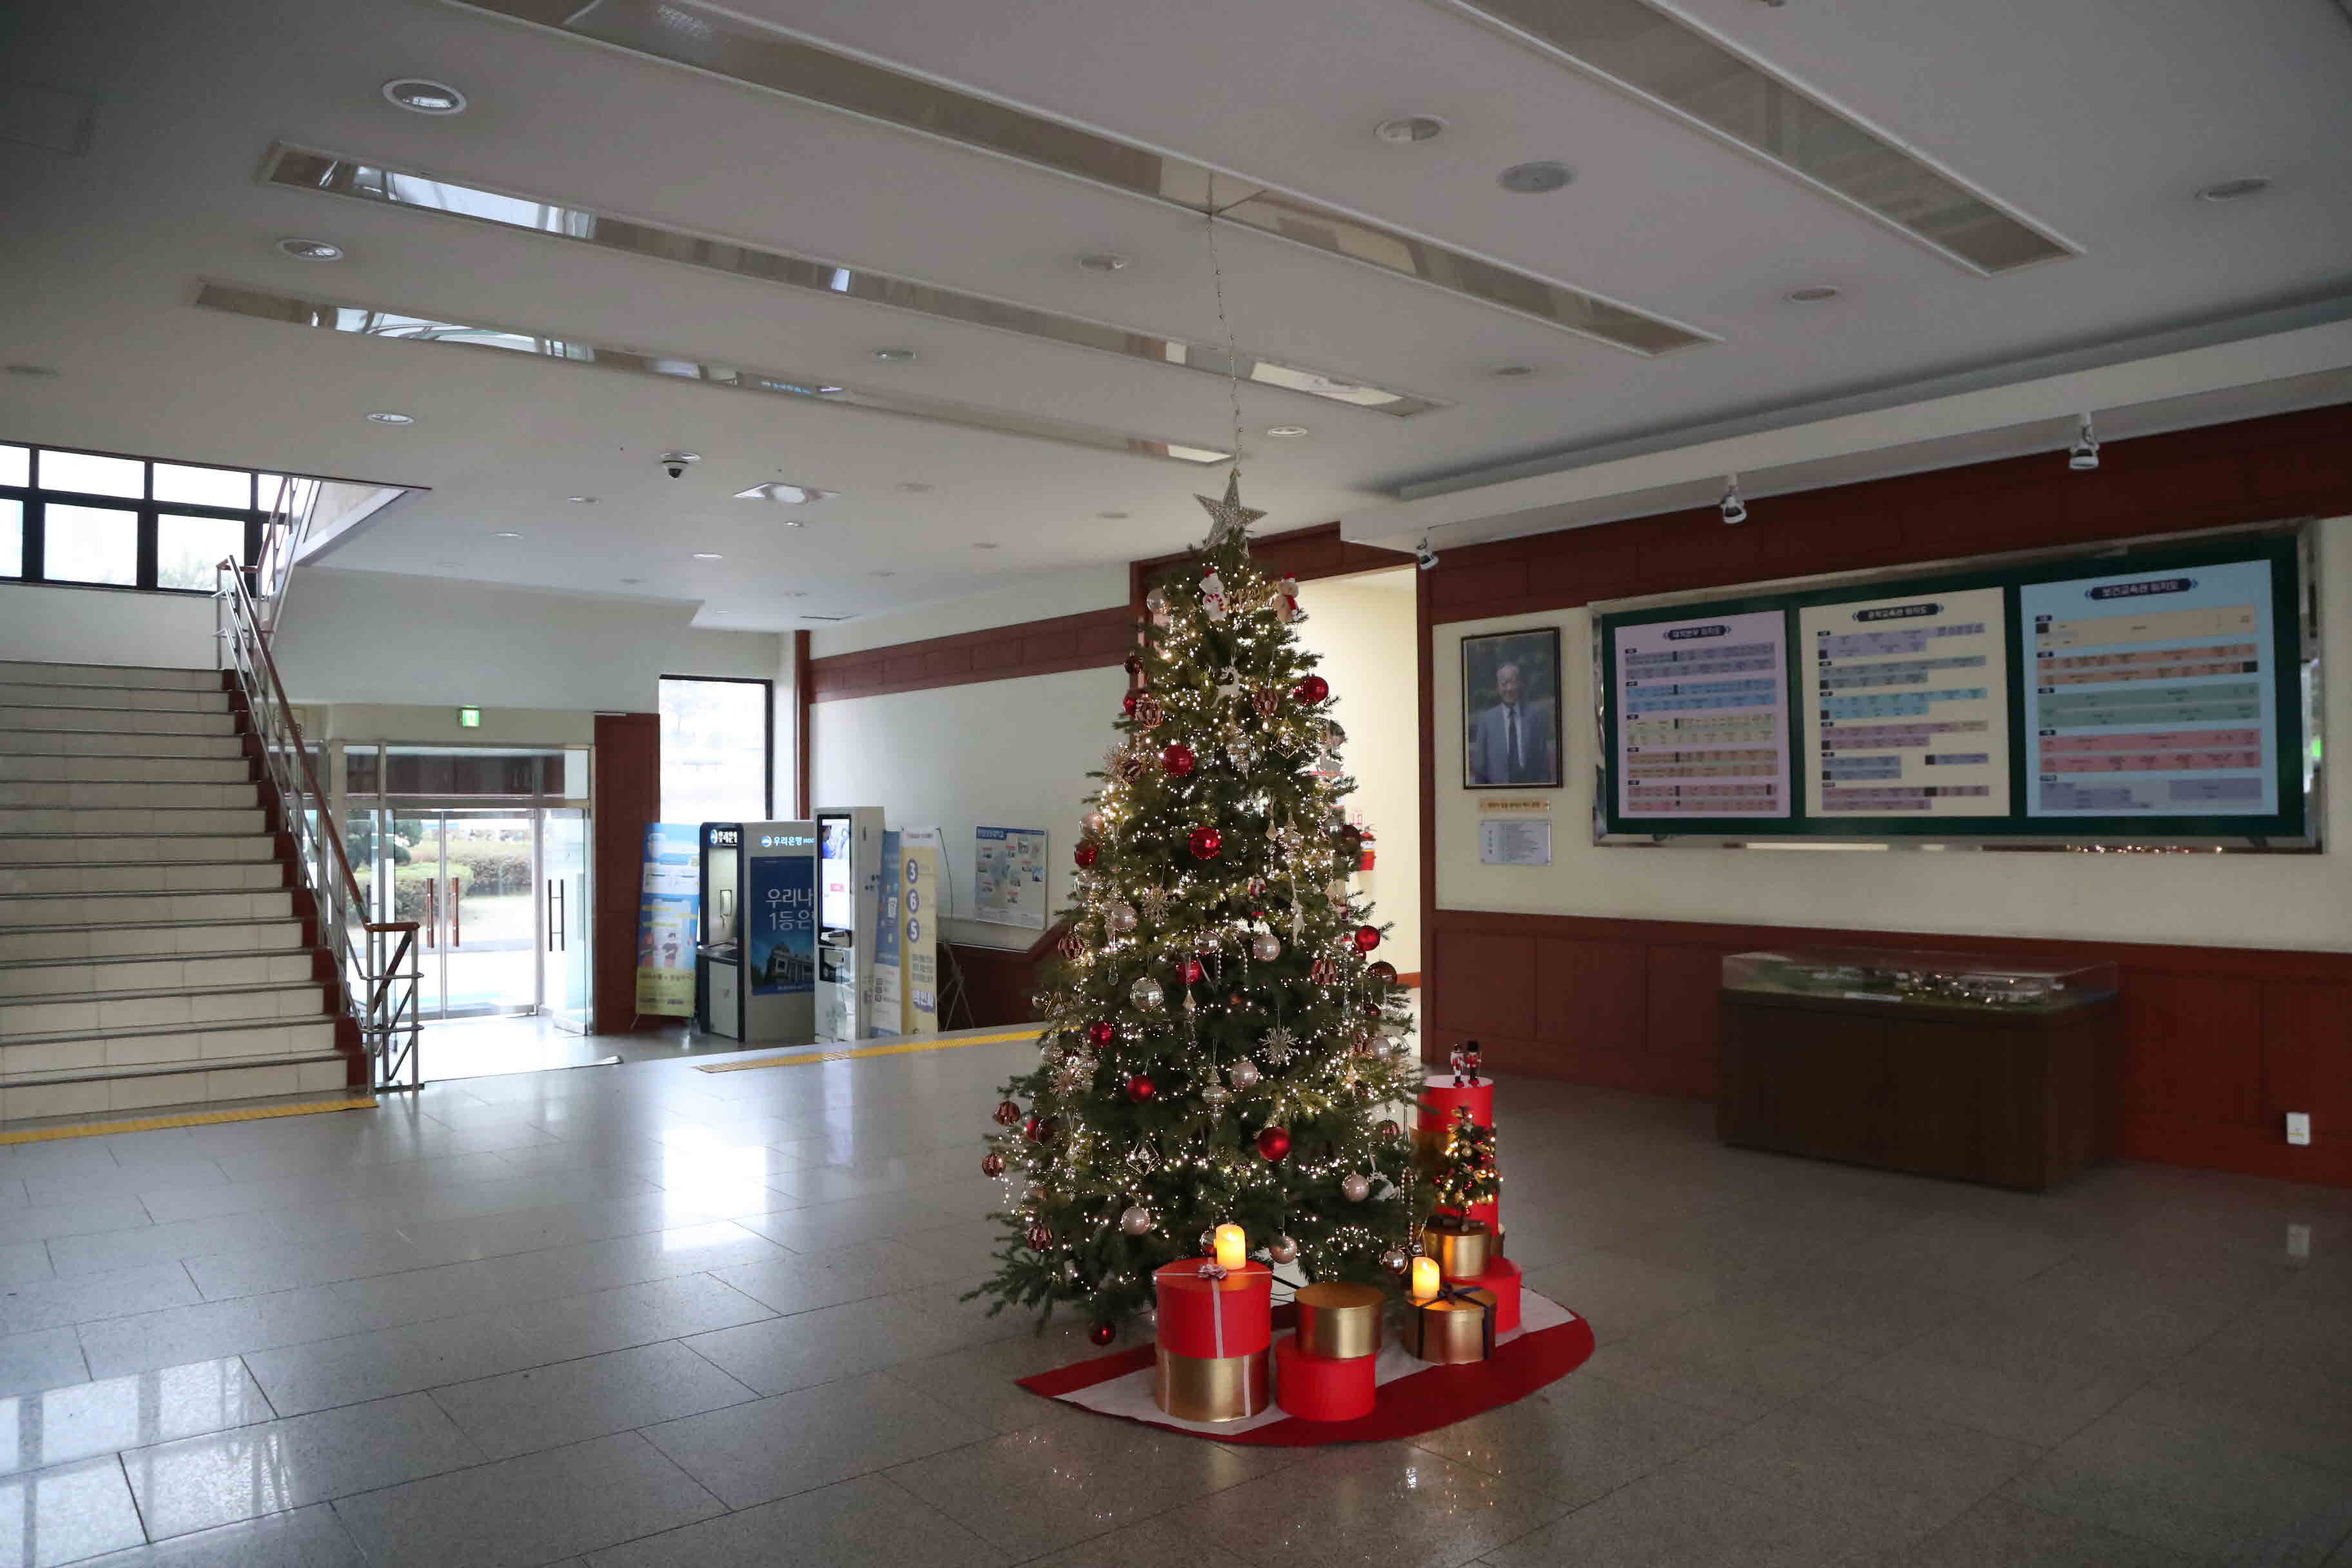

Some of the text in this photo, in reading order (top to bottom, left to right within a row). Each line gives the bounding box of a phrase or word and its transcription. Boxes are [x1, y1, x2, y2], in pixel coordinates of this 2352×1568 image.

[774, 836, 802, 846] 우리은행
[908, 861, 916, 881] 3
[910, 892, 917, 910] 6
[769, 910, 814, 931] 1등은
[910, 922, 917, 939] 5
